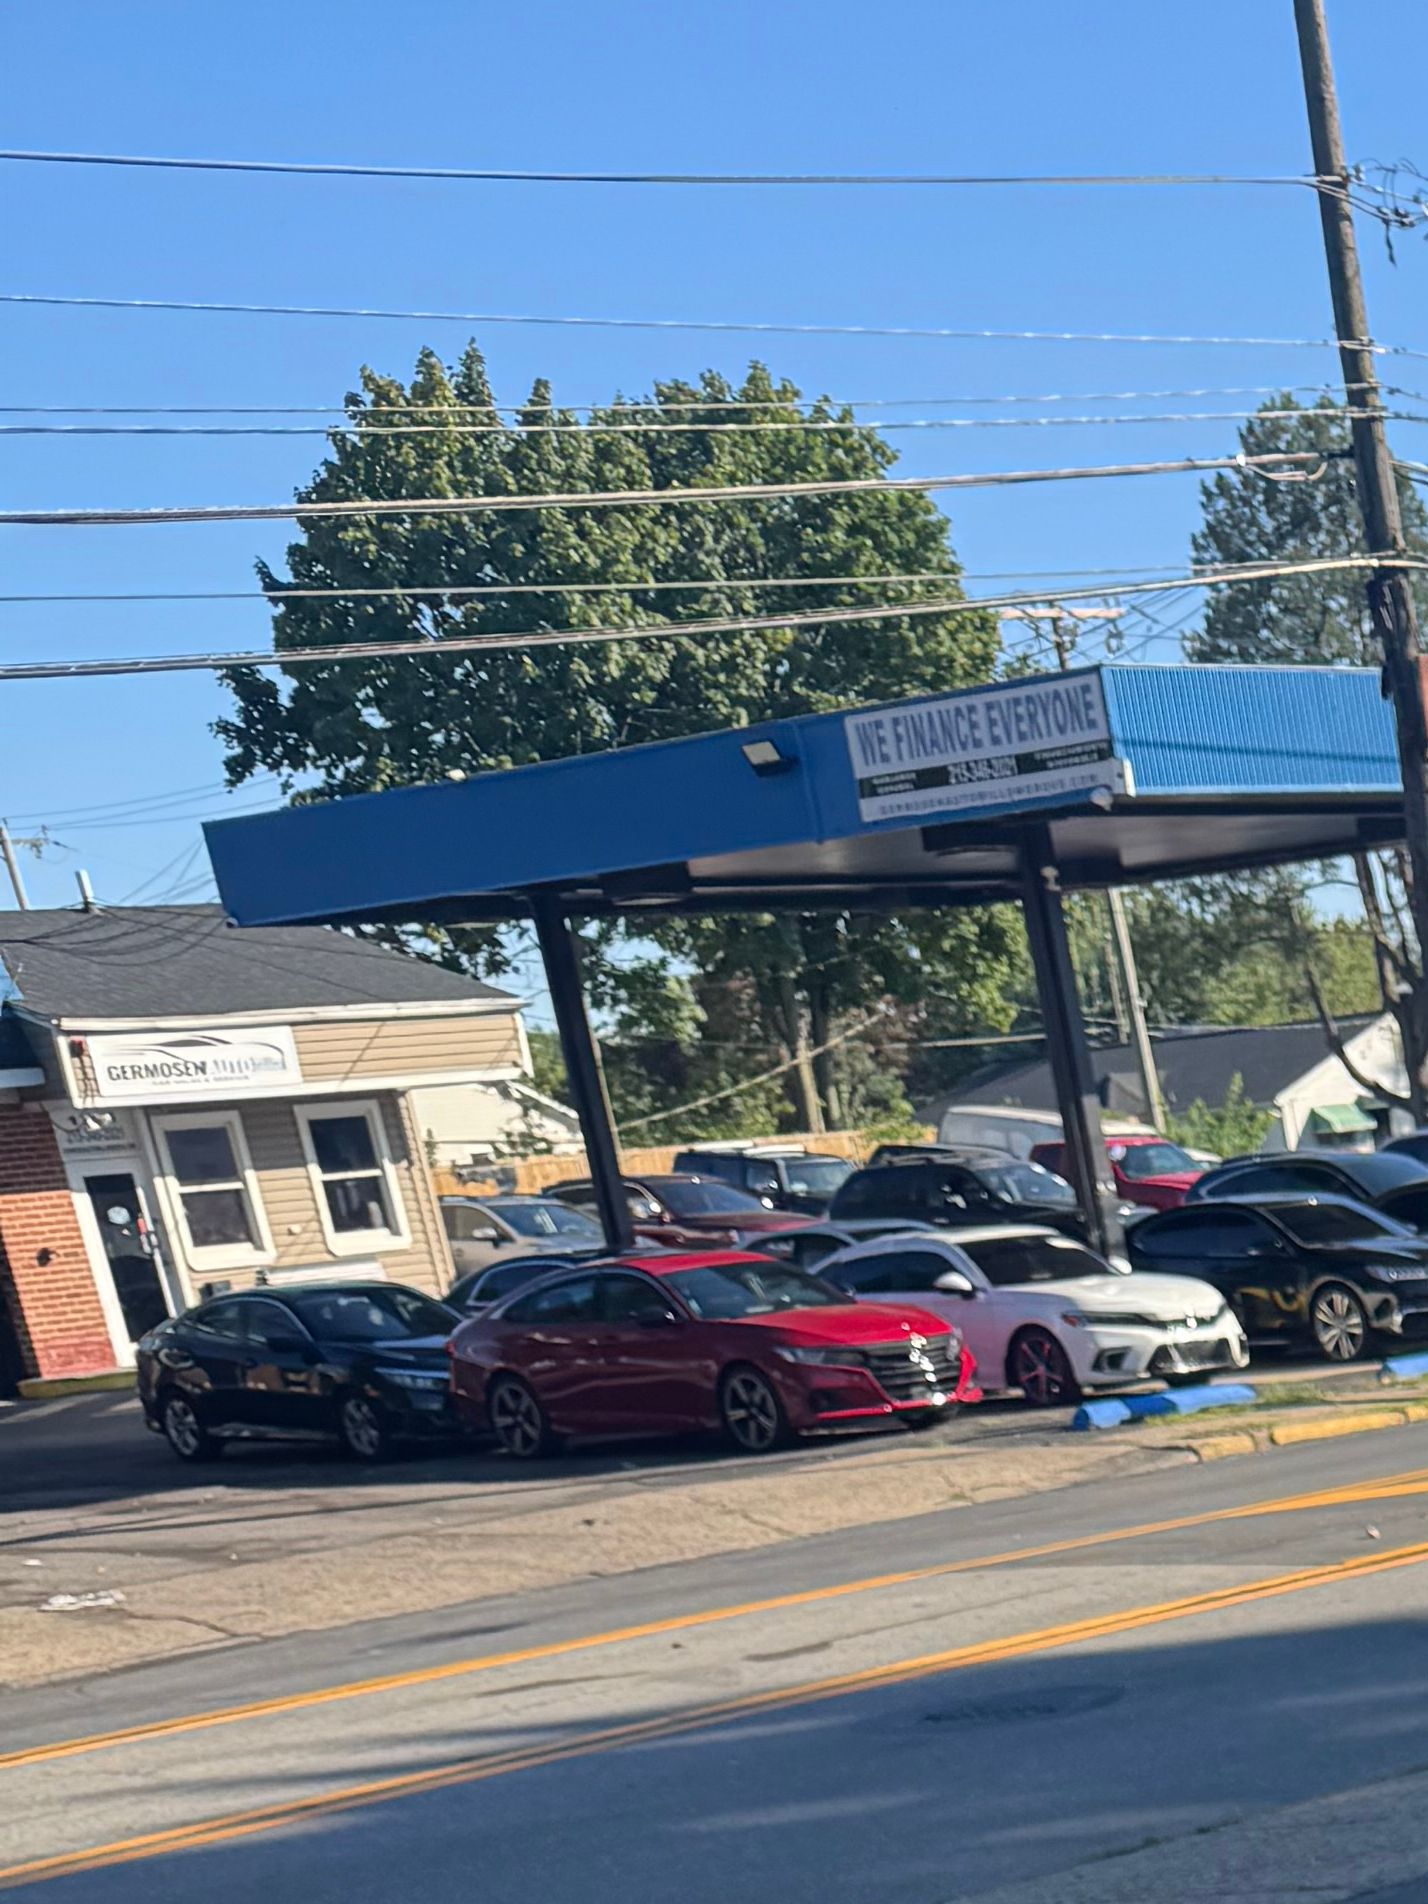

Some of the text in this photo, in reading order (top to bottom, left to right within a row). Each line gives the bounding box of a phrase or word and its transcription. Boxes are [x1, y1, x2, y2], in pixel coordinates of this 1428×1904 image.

[854, 718, 889, 767] WE
[892, 703, 984, 762] FINANCE
[985, 683, 1099, 747] EVERYONE
[107, 1060, 208, 1082] GERMOSEN
